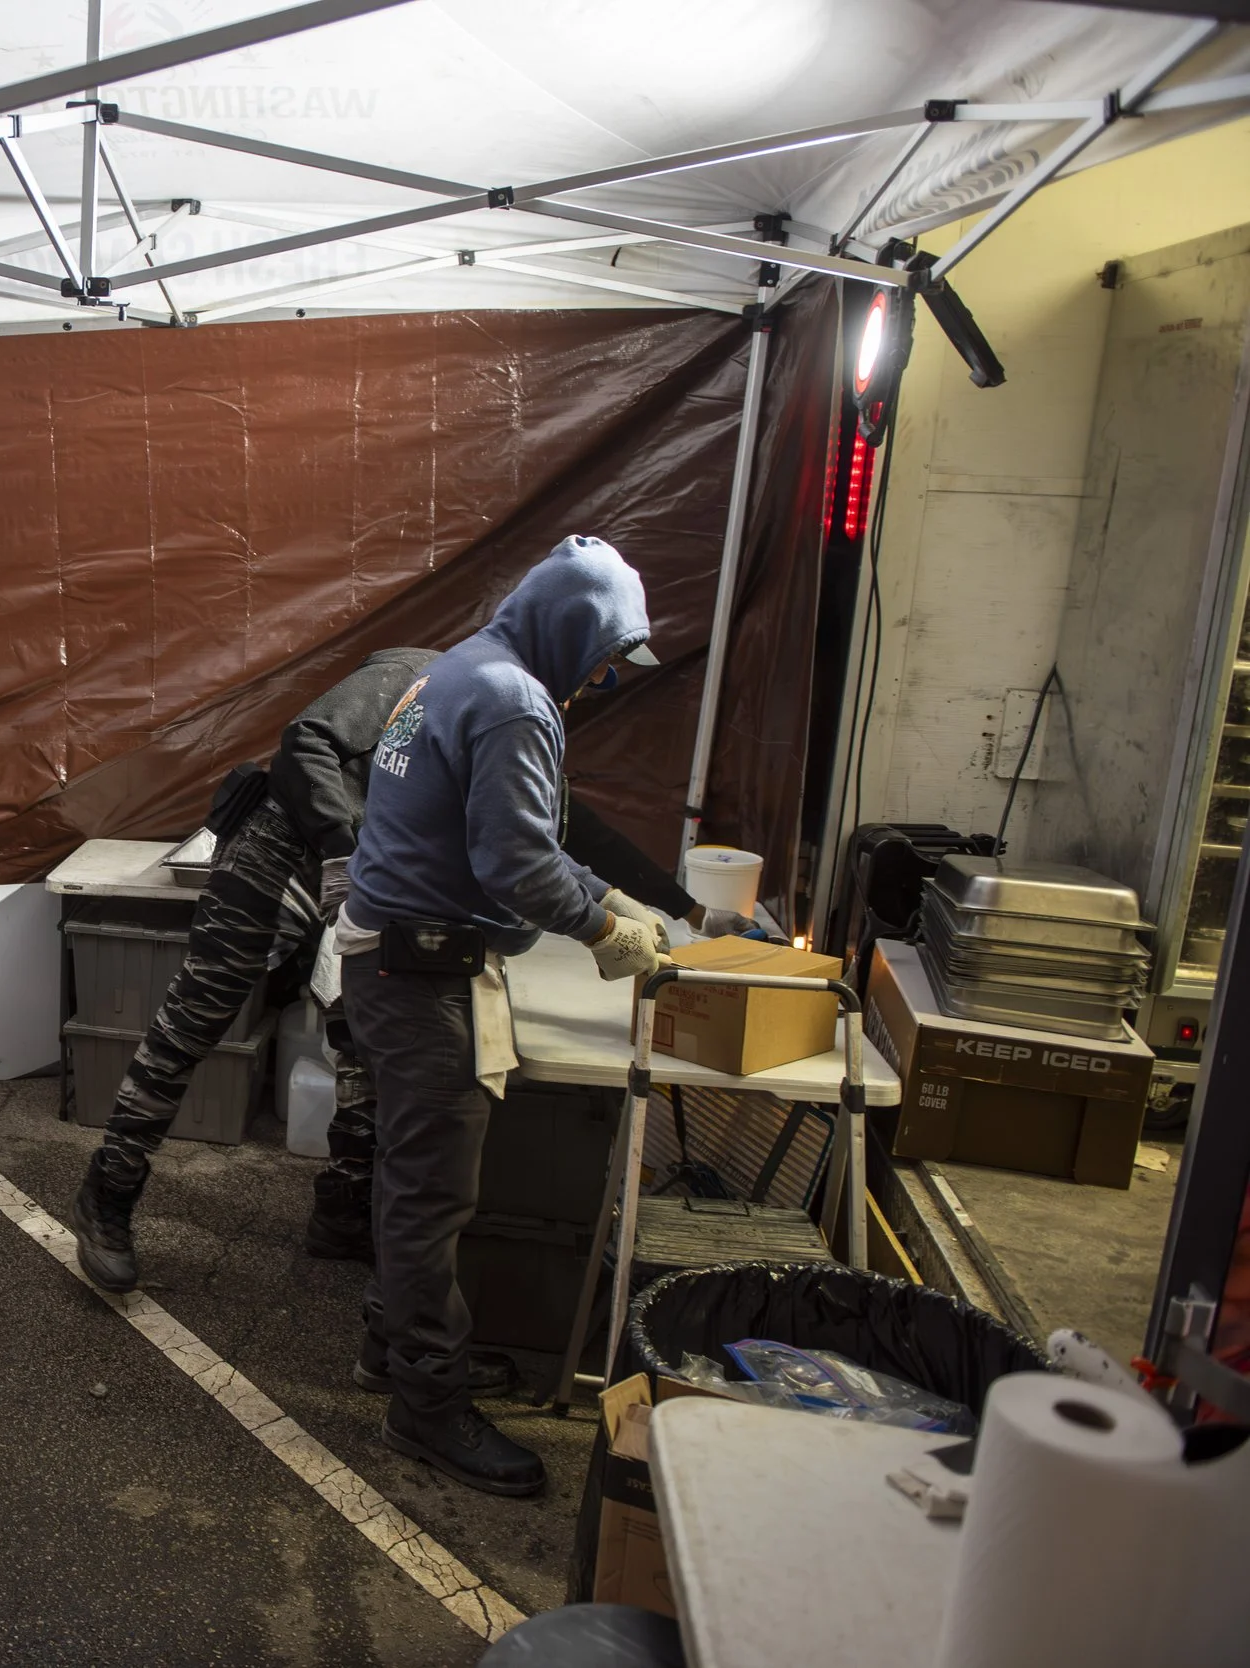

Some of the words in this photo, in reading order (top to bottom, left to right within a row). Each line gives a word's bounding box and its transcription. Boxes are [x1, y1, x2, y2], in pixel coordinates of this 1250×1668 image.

[955, 1038, 1032, 1061] KEEP
[1041, 1050, 1111, 1074] ICED
[921, 1083, 934, 1095] 60
[936, 1083, 949, 1097] LB
[918, 1095, 947, 1111] COVER
